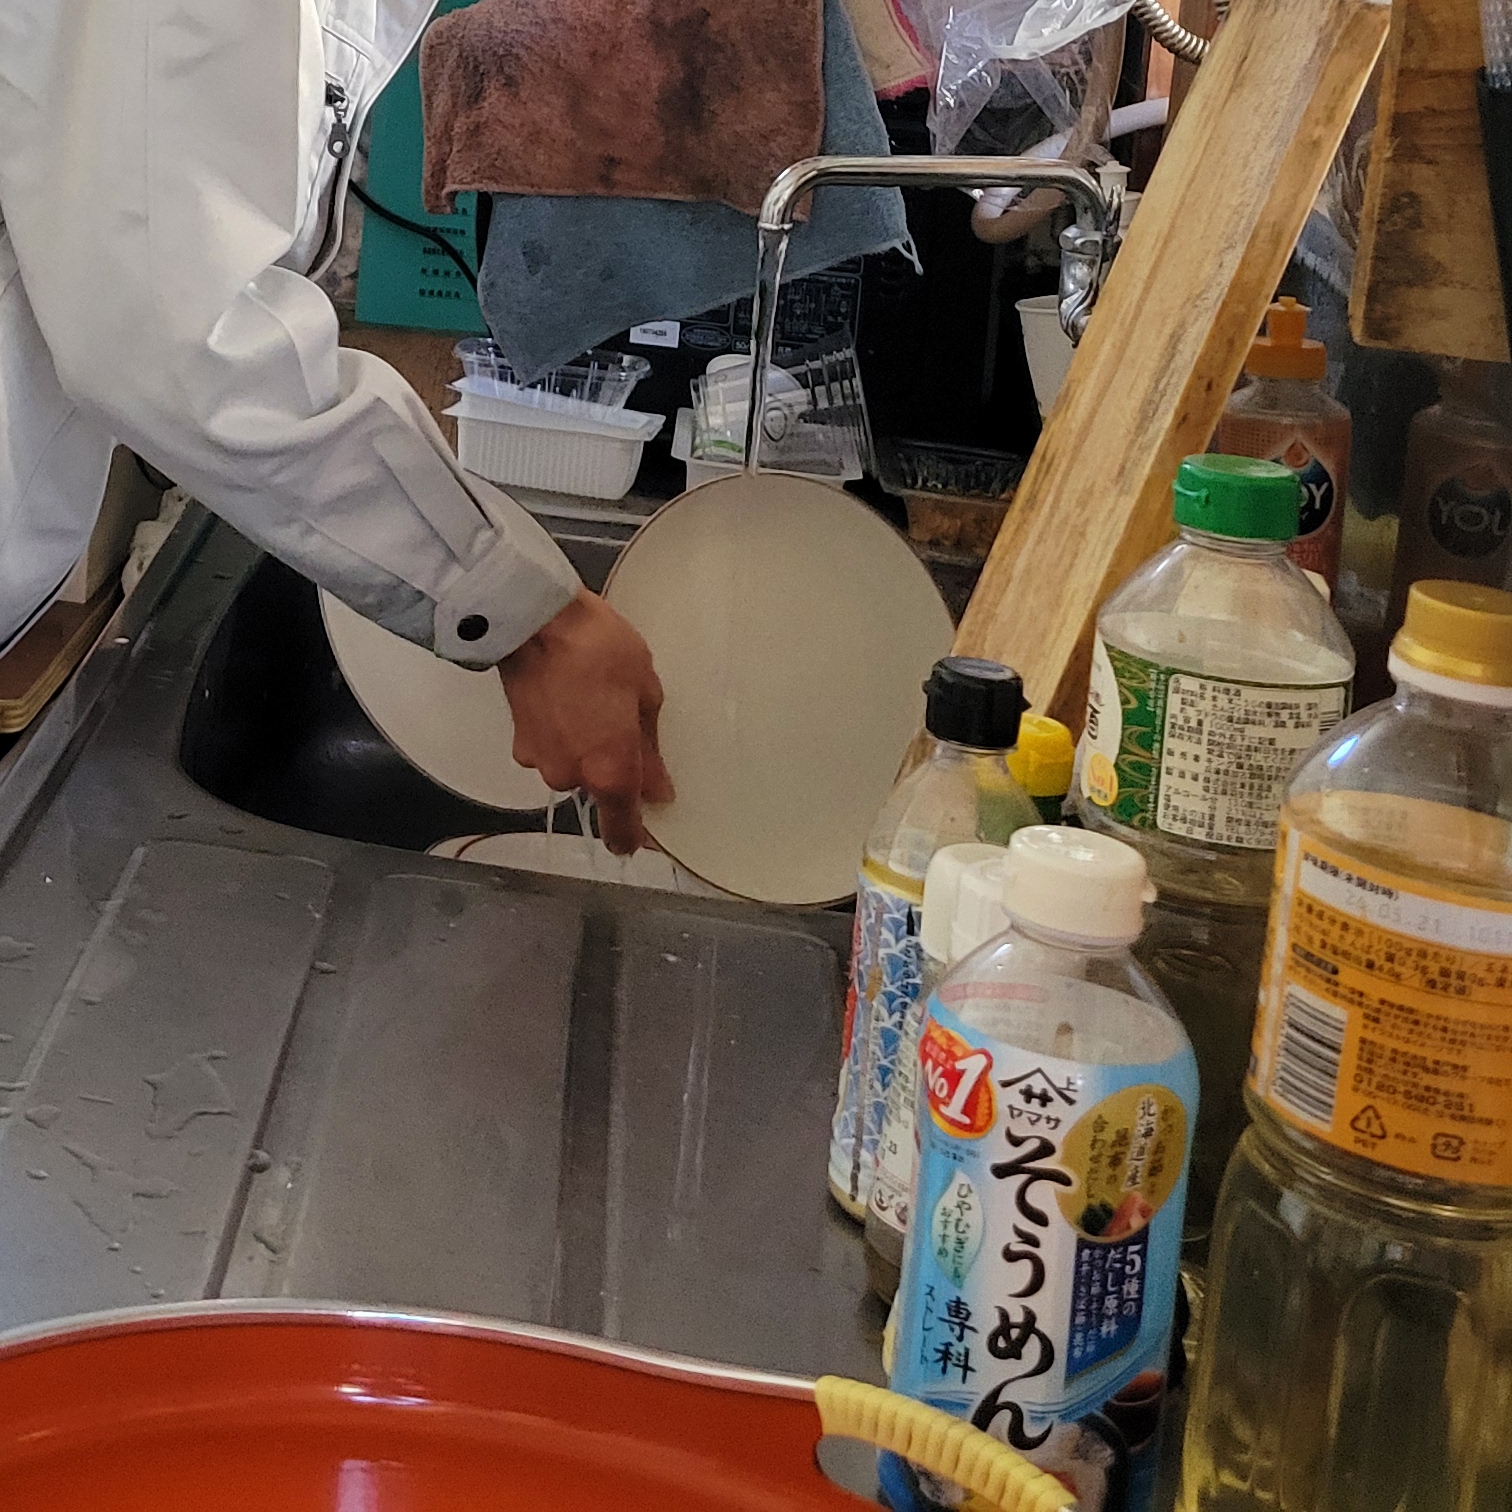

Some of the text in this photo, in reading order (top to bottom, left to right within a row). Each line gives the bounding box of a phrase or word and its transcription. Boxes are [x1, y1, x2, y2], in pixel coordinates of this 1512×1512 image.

[1006, 1103, 1062, 1131] ヤマサ
[1125, 1095, 1158, 1188] 北海道産
[970, 1126, 1074, 1451] そうめん
[1099, 1245, 1126, 1339] だし原料
[1121, 1243, 1144, 1316] 5種の
[932, 1295, 980, 1385] 専科
